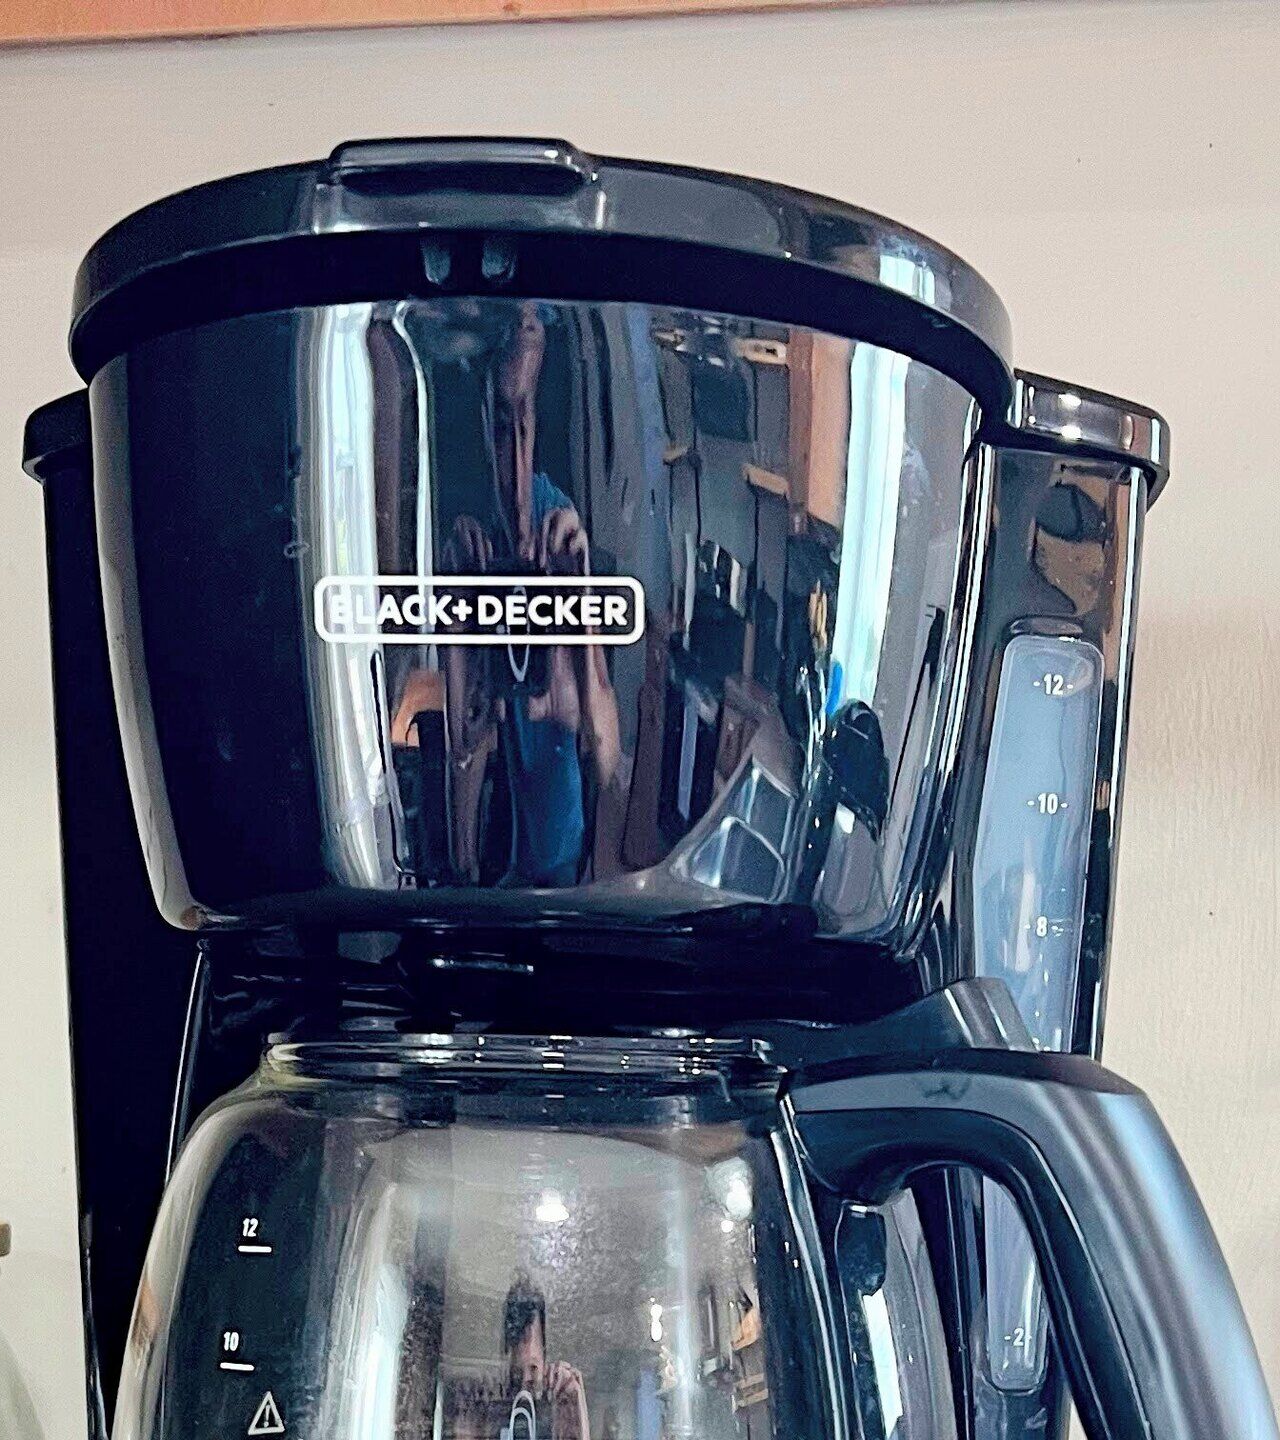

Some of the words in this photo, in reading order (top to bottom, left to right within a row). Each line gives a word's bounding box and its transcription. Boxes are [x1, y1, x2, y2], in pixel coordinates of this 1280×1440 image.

[329, 593, 628, 627] BLACK+DECKER
[242, 1217, 259, 1237] 12
[223, 1331, 240, 1352] 10
